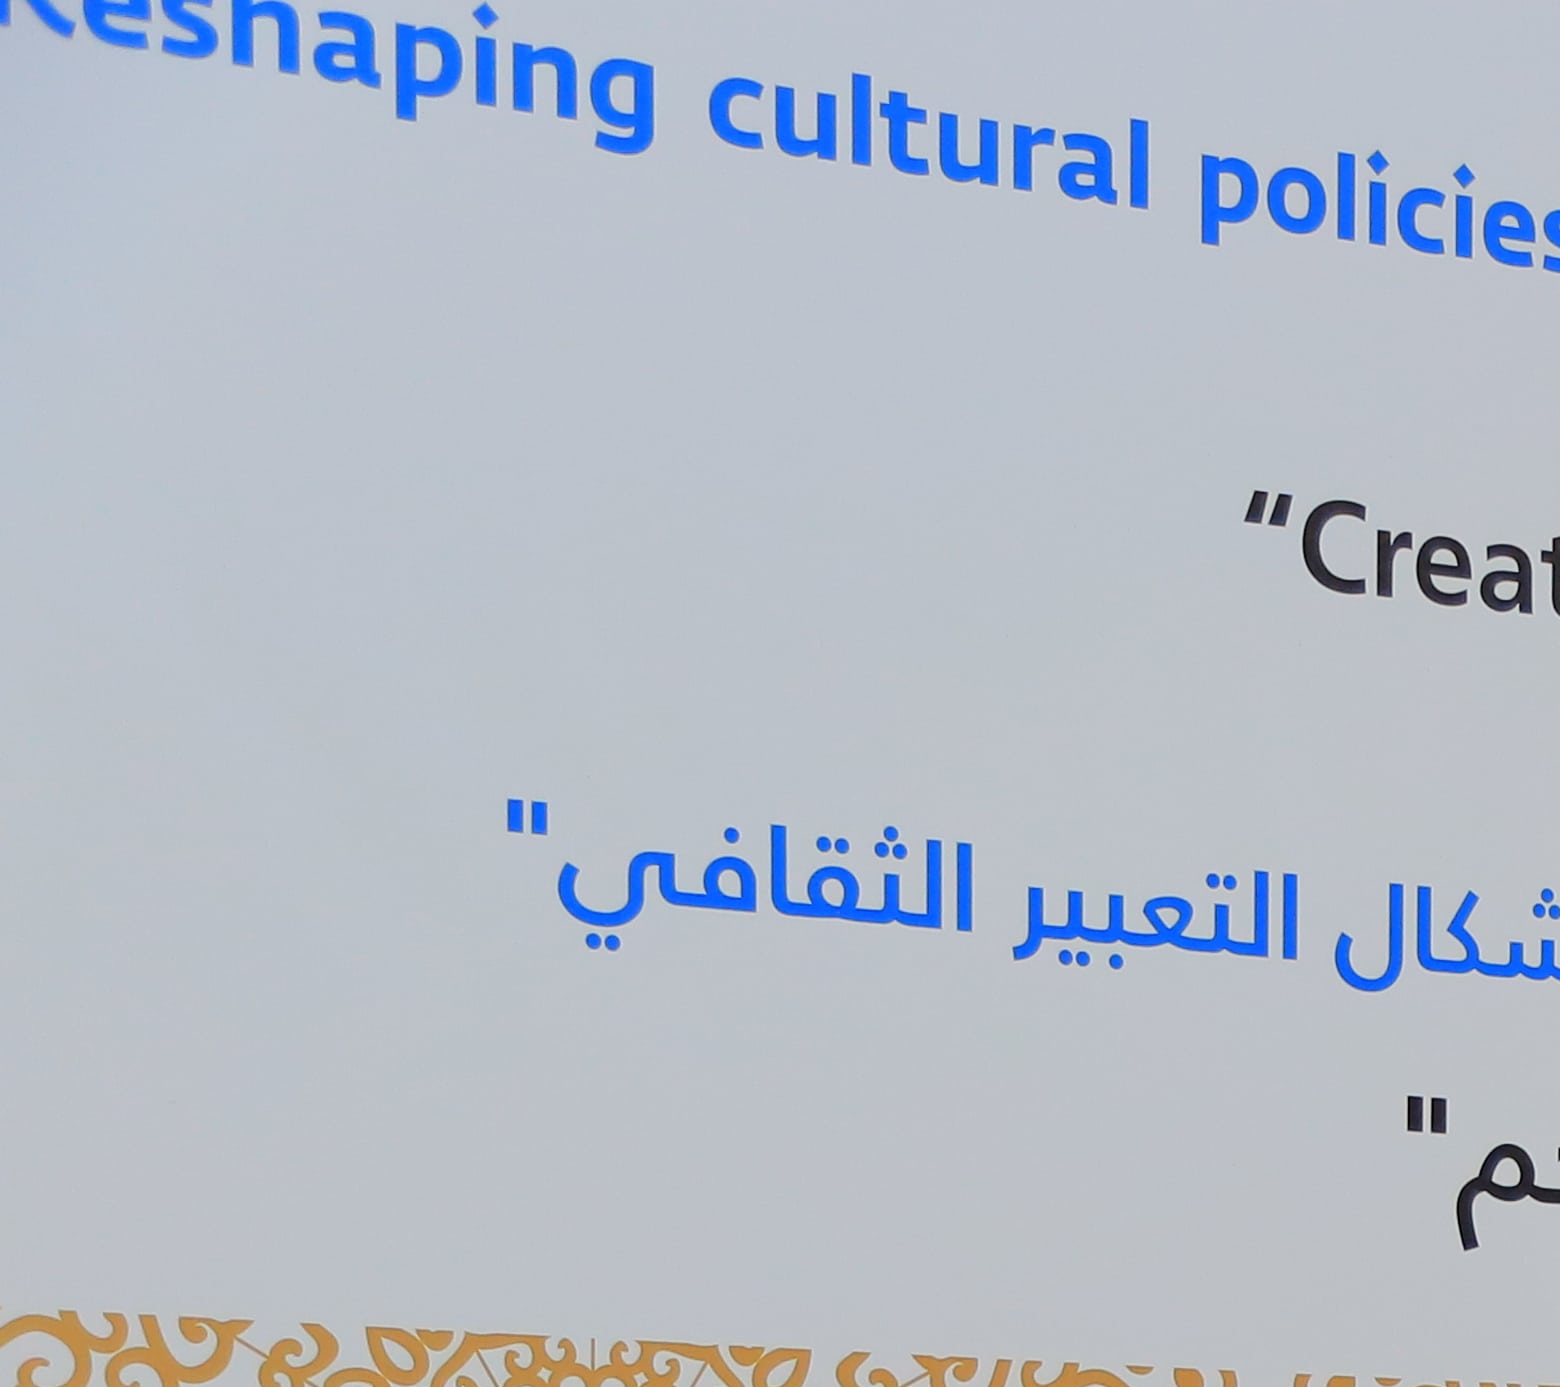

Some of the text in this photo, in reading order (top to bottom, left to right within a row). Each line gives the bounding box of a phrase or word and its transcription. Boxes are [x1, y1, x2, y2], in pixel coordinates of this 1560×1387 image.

[707, 71, 1150, 210] cultural
[506, 797, 974, 952] الثقافي"
[1011, 869, 1300, 970] التعبير
